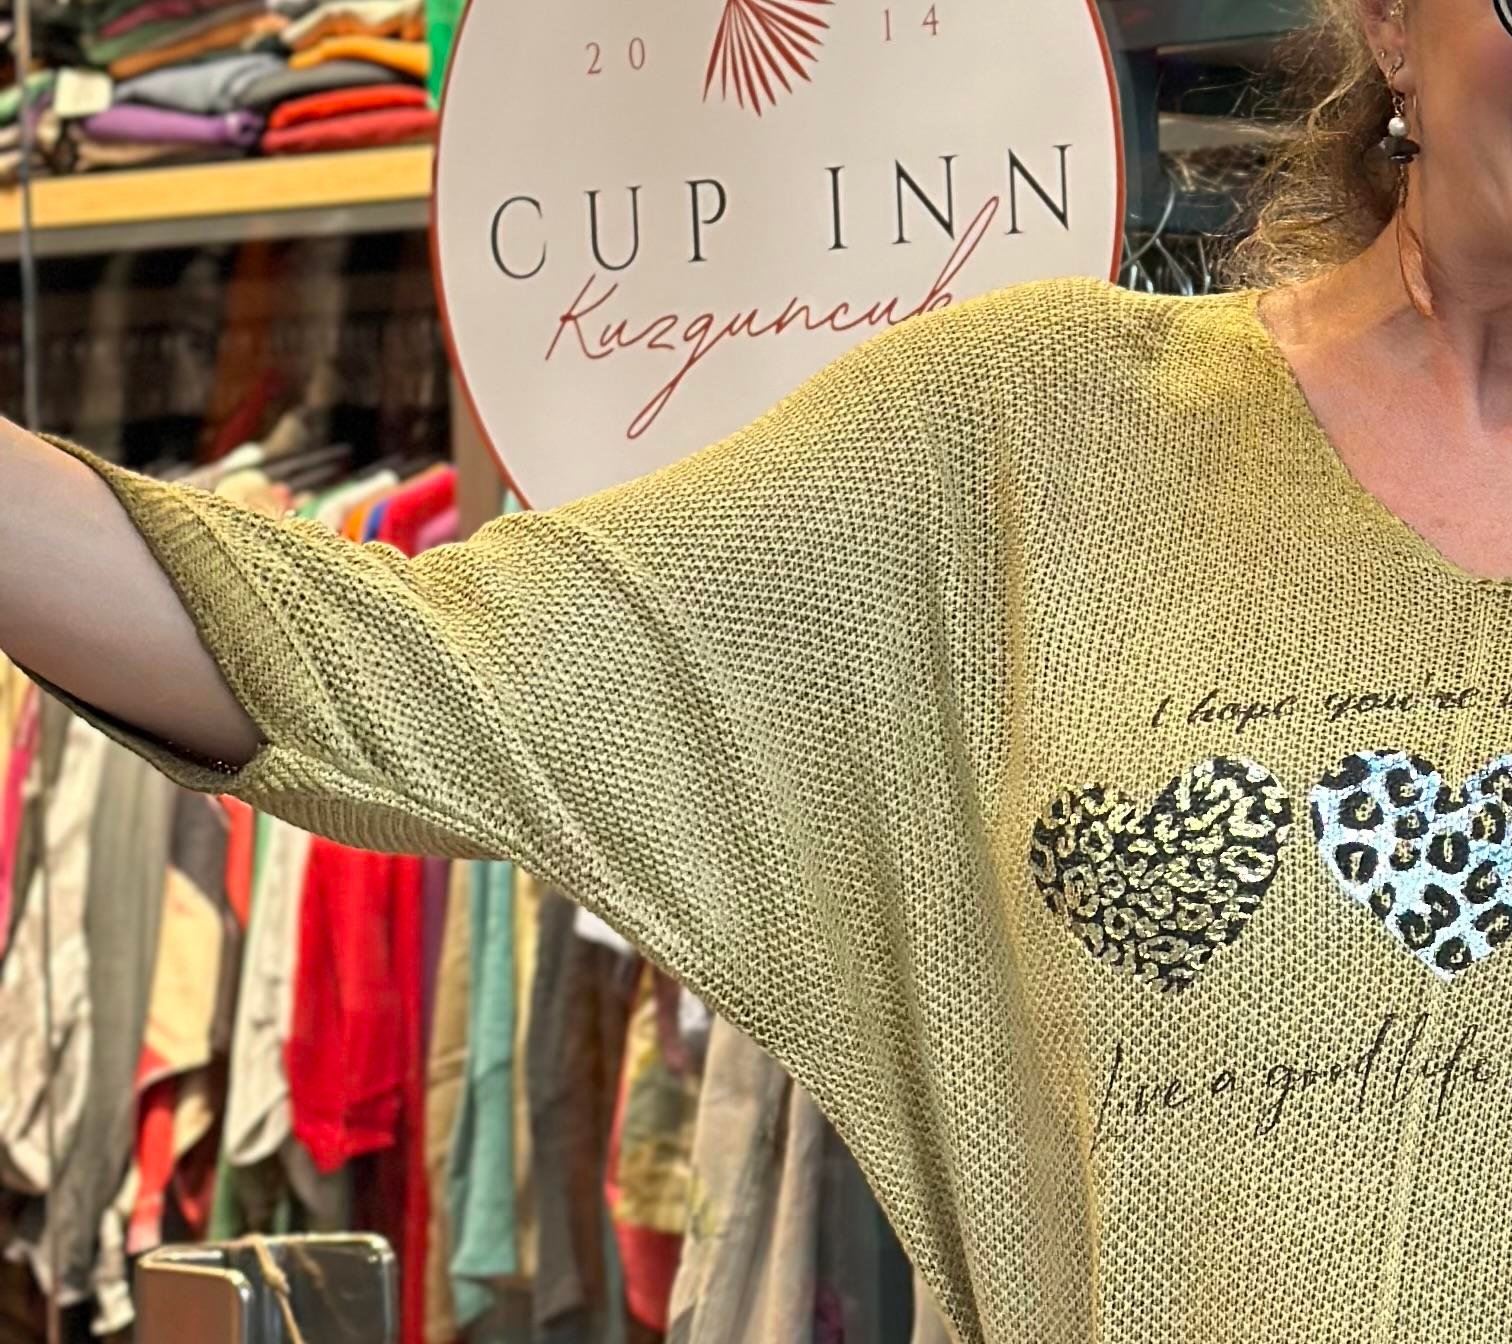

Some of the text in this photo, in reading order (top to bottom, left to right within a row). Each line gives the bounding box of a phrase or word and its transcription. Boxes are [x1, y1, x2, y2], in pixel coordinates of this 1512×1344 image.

[585, 3, 940, 75] 20 14
[489, 143, 1074, 280] CUP INN
[1151, 694, 1172, 728] I
[1186, 687, 1298, 734] hope
[1323, 670, 1481, 723] you're
[1210, 1067, 1242, 1097] a
[1254, 1012, 1396, 1136] good
